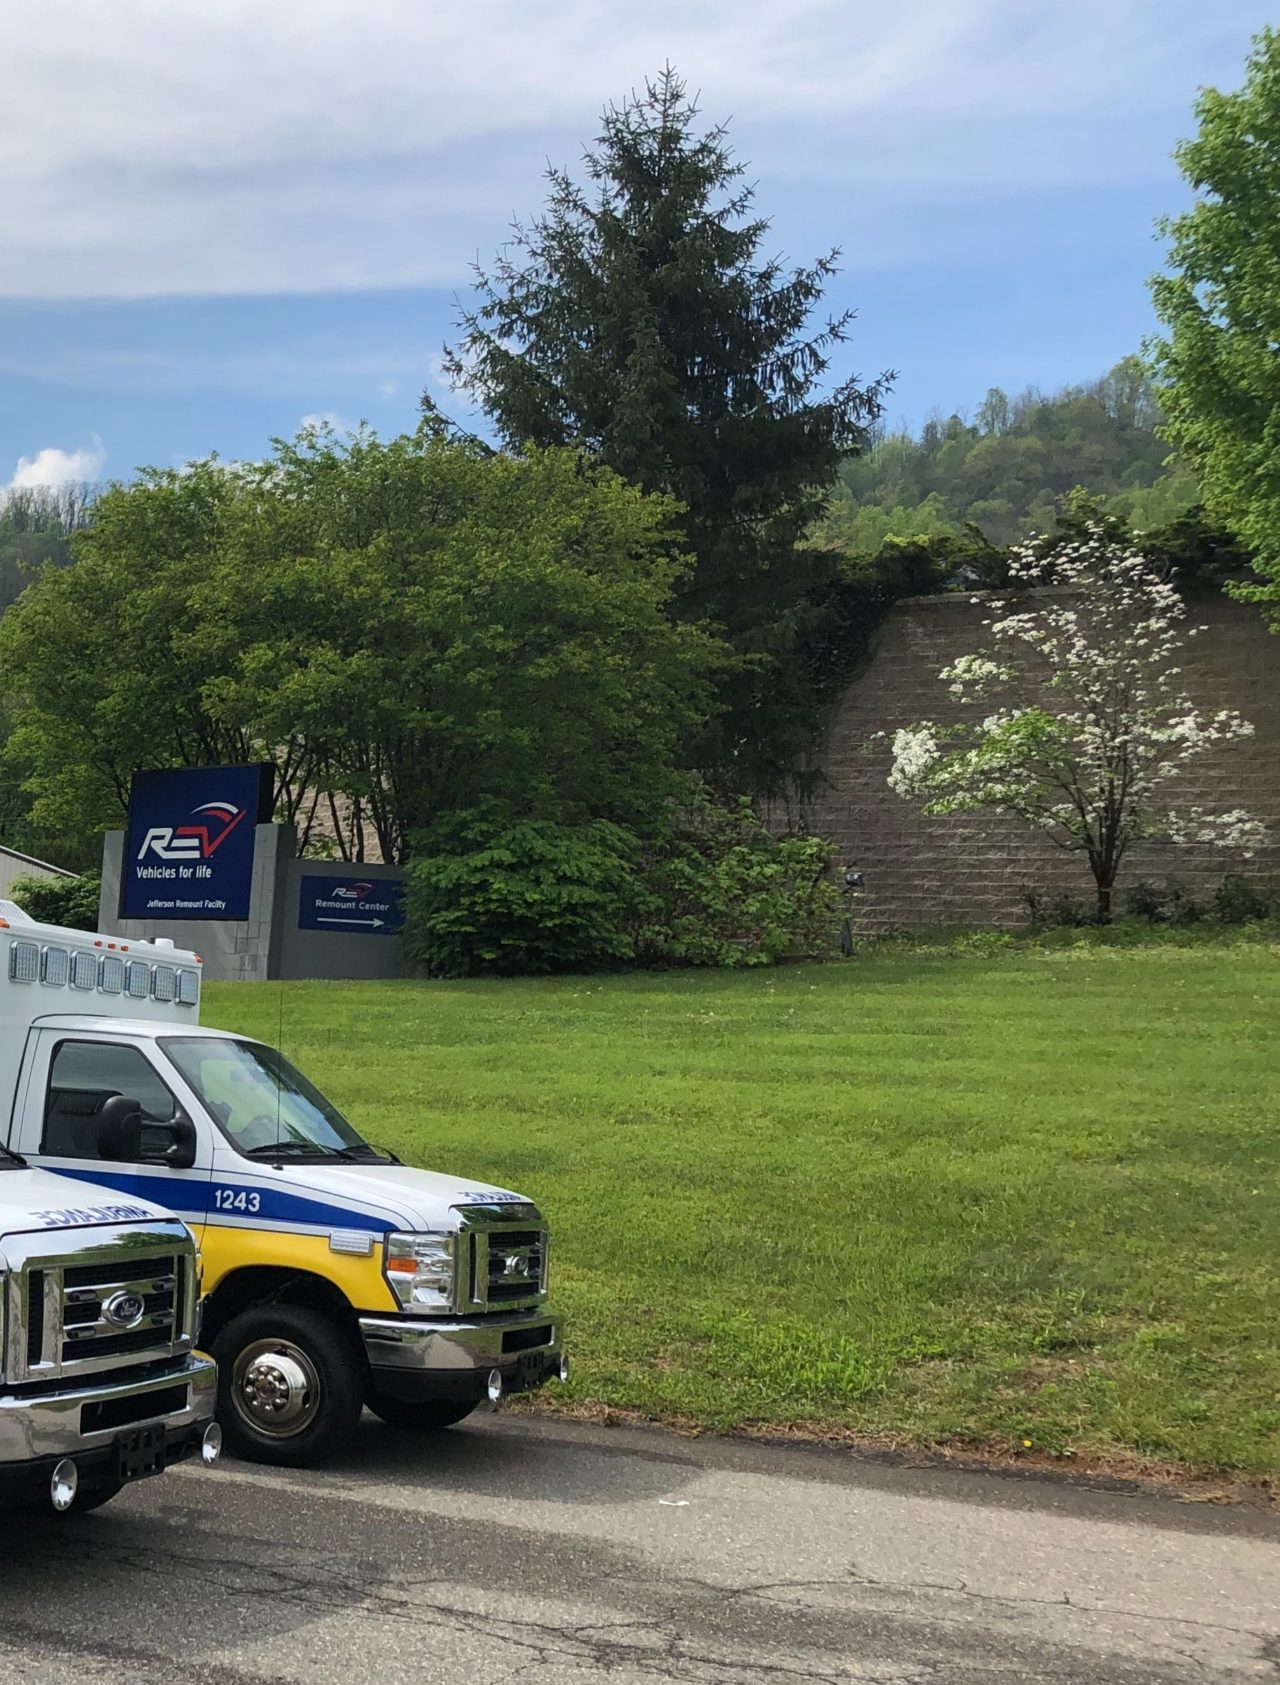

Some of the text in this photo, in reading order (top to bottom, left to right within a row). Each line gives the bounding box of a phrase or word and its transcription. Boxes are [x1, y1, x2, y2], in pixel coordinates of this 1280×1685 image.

[137, 809, 246, 859] REV
[136, 865, 212, 879] Vehicles for life
[147, 899, 226, 910] Jefferson Remount Facility
[315, 899, 390, 911] Remount Center
[214, 1189, 261, 1212] 1243
